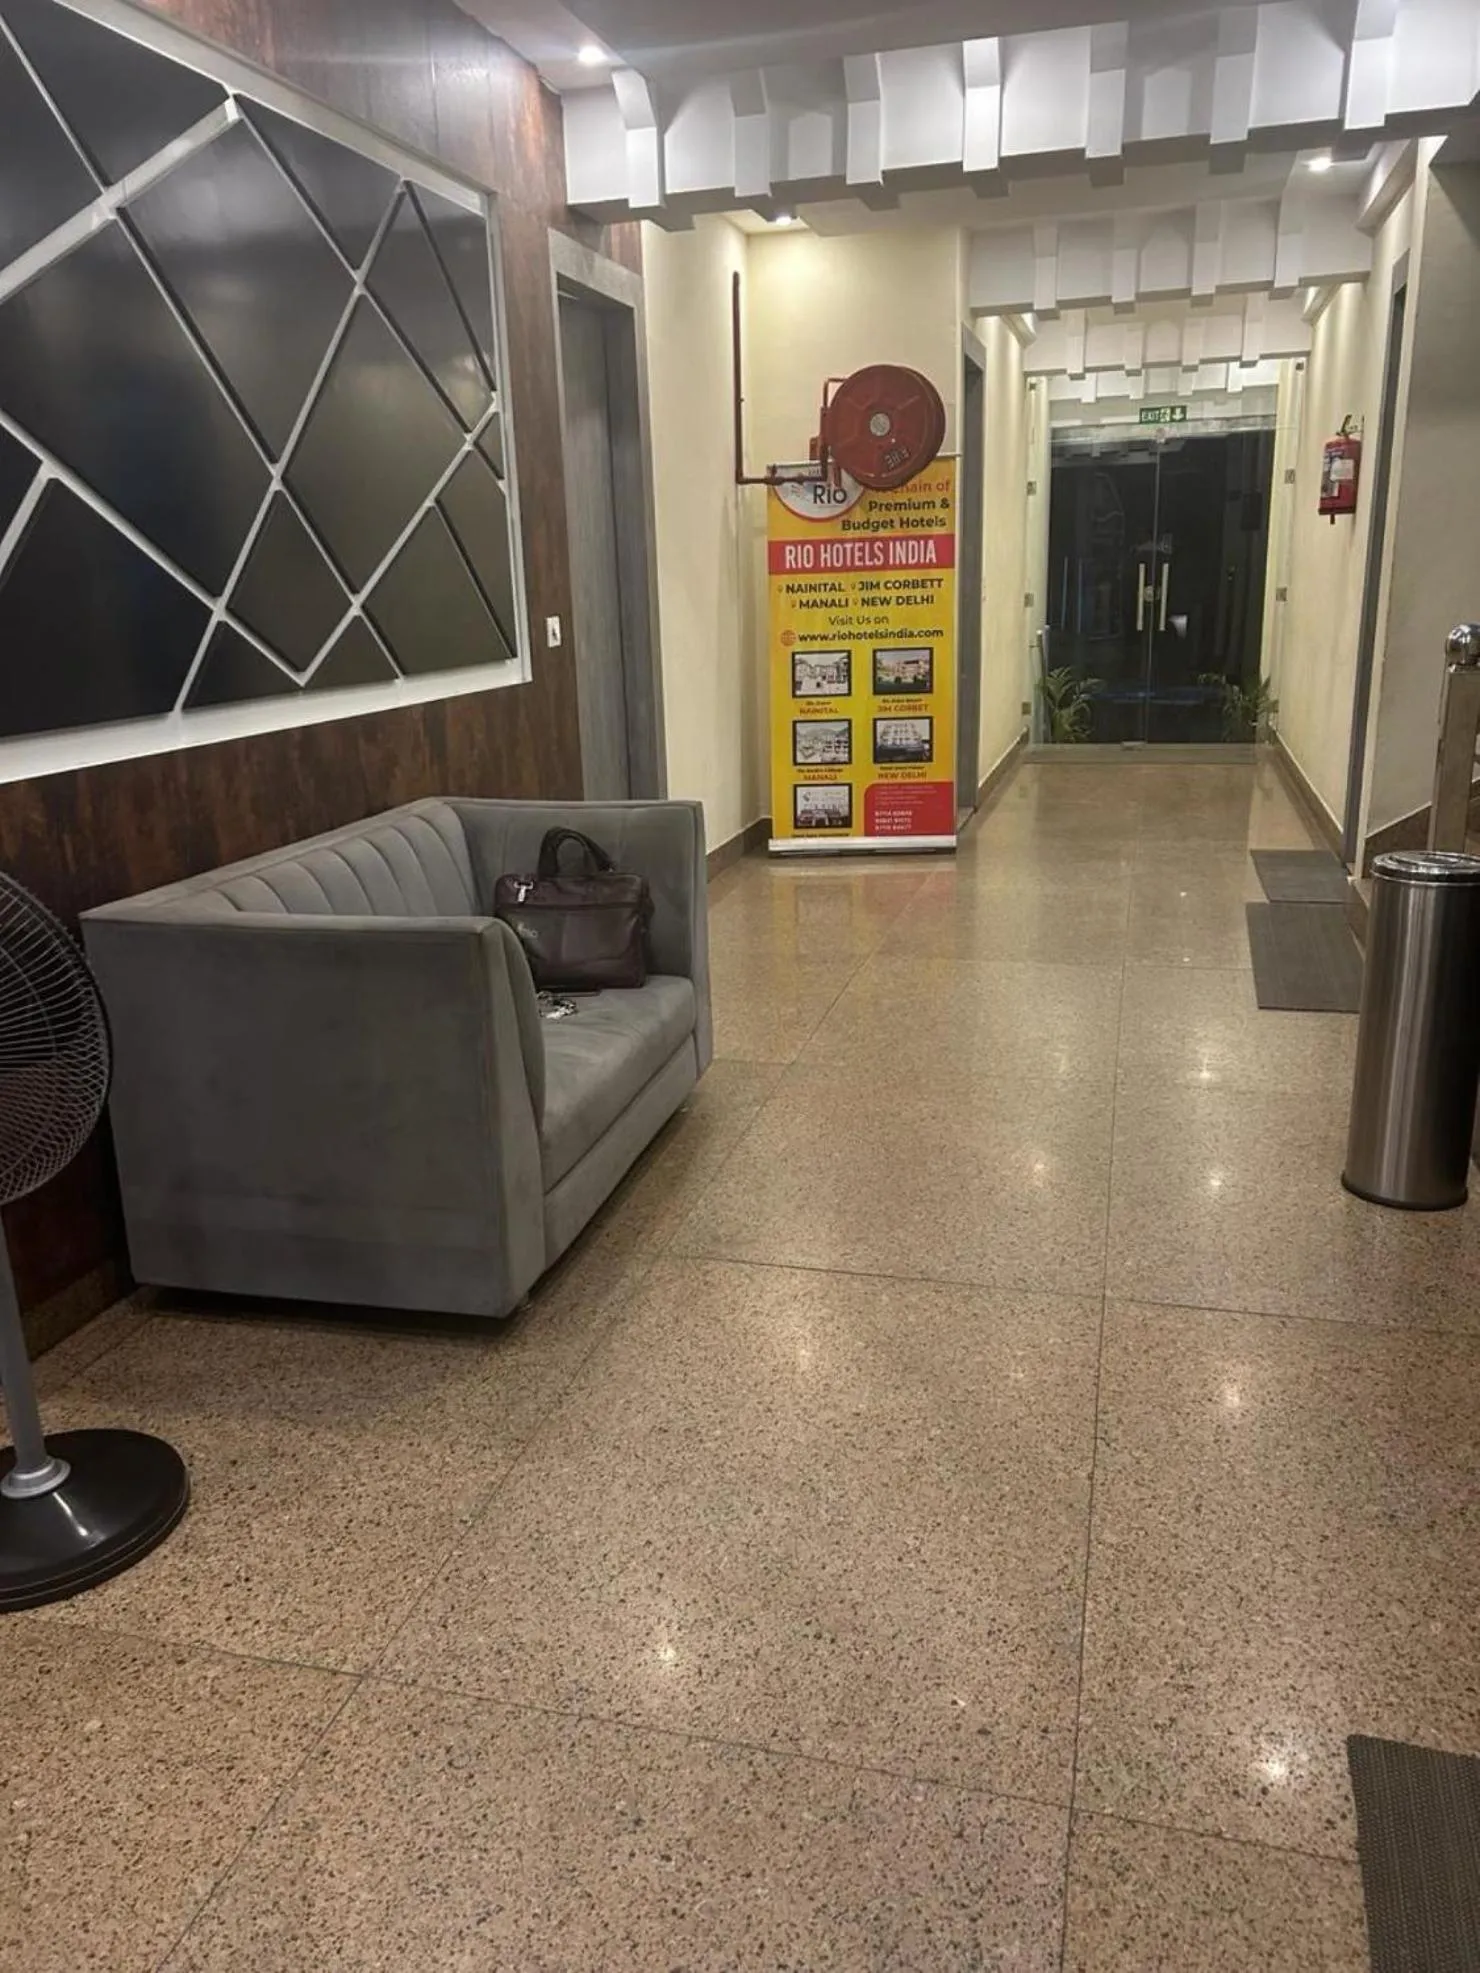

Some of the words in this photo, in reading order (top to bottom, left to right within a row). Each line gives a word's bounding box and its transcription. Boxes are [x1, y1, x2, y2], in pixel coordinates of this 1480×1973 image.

[1141, 410, 1160, 420] EXIT
[936, 478, 950, 491] of
[813, 484, 848, 504] Rio
[868, 499, 936, 512] Premium
[940, 498, 950, 508] &
[842, 517, 895, 532] Budget
[900, 516, 946, 528] Hotels
[785, 545, 813, 569] RIO
[820, 542, 884, 567] HOTELS
[889, 540, 937, 564] INDIA
[786, 583, 845, 594] NAINITAL
[858, 581, 881, 591] JIM
[883, 578, 944, 590] CORBETT
[799, 599, 849, 609] MANALI
[861, 597, 891, 607] NEW
[895, 595, 934, 606] DELHI
[829, 616, 853, 626] Visit
[856, 616, 872, 625] Us
[875, 616, 889, 625] on
[798, 629, 944, 642] www.riohotelsindia.com
